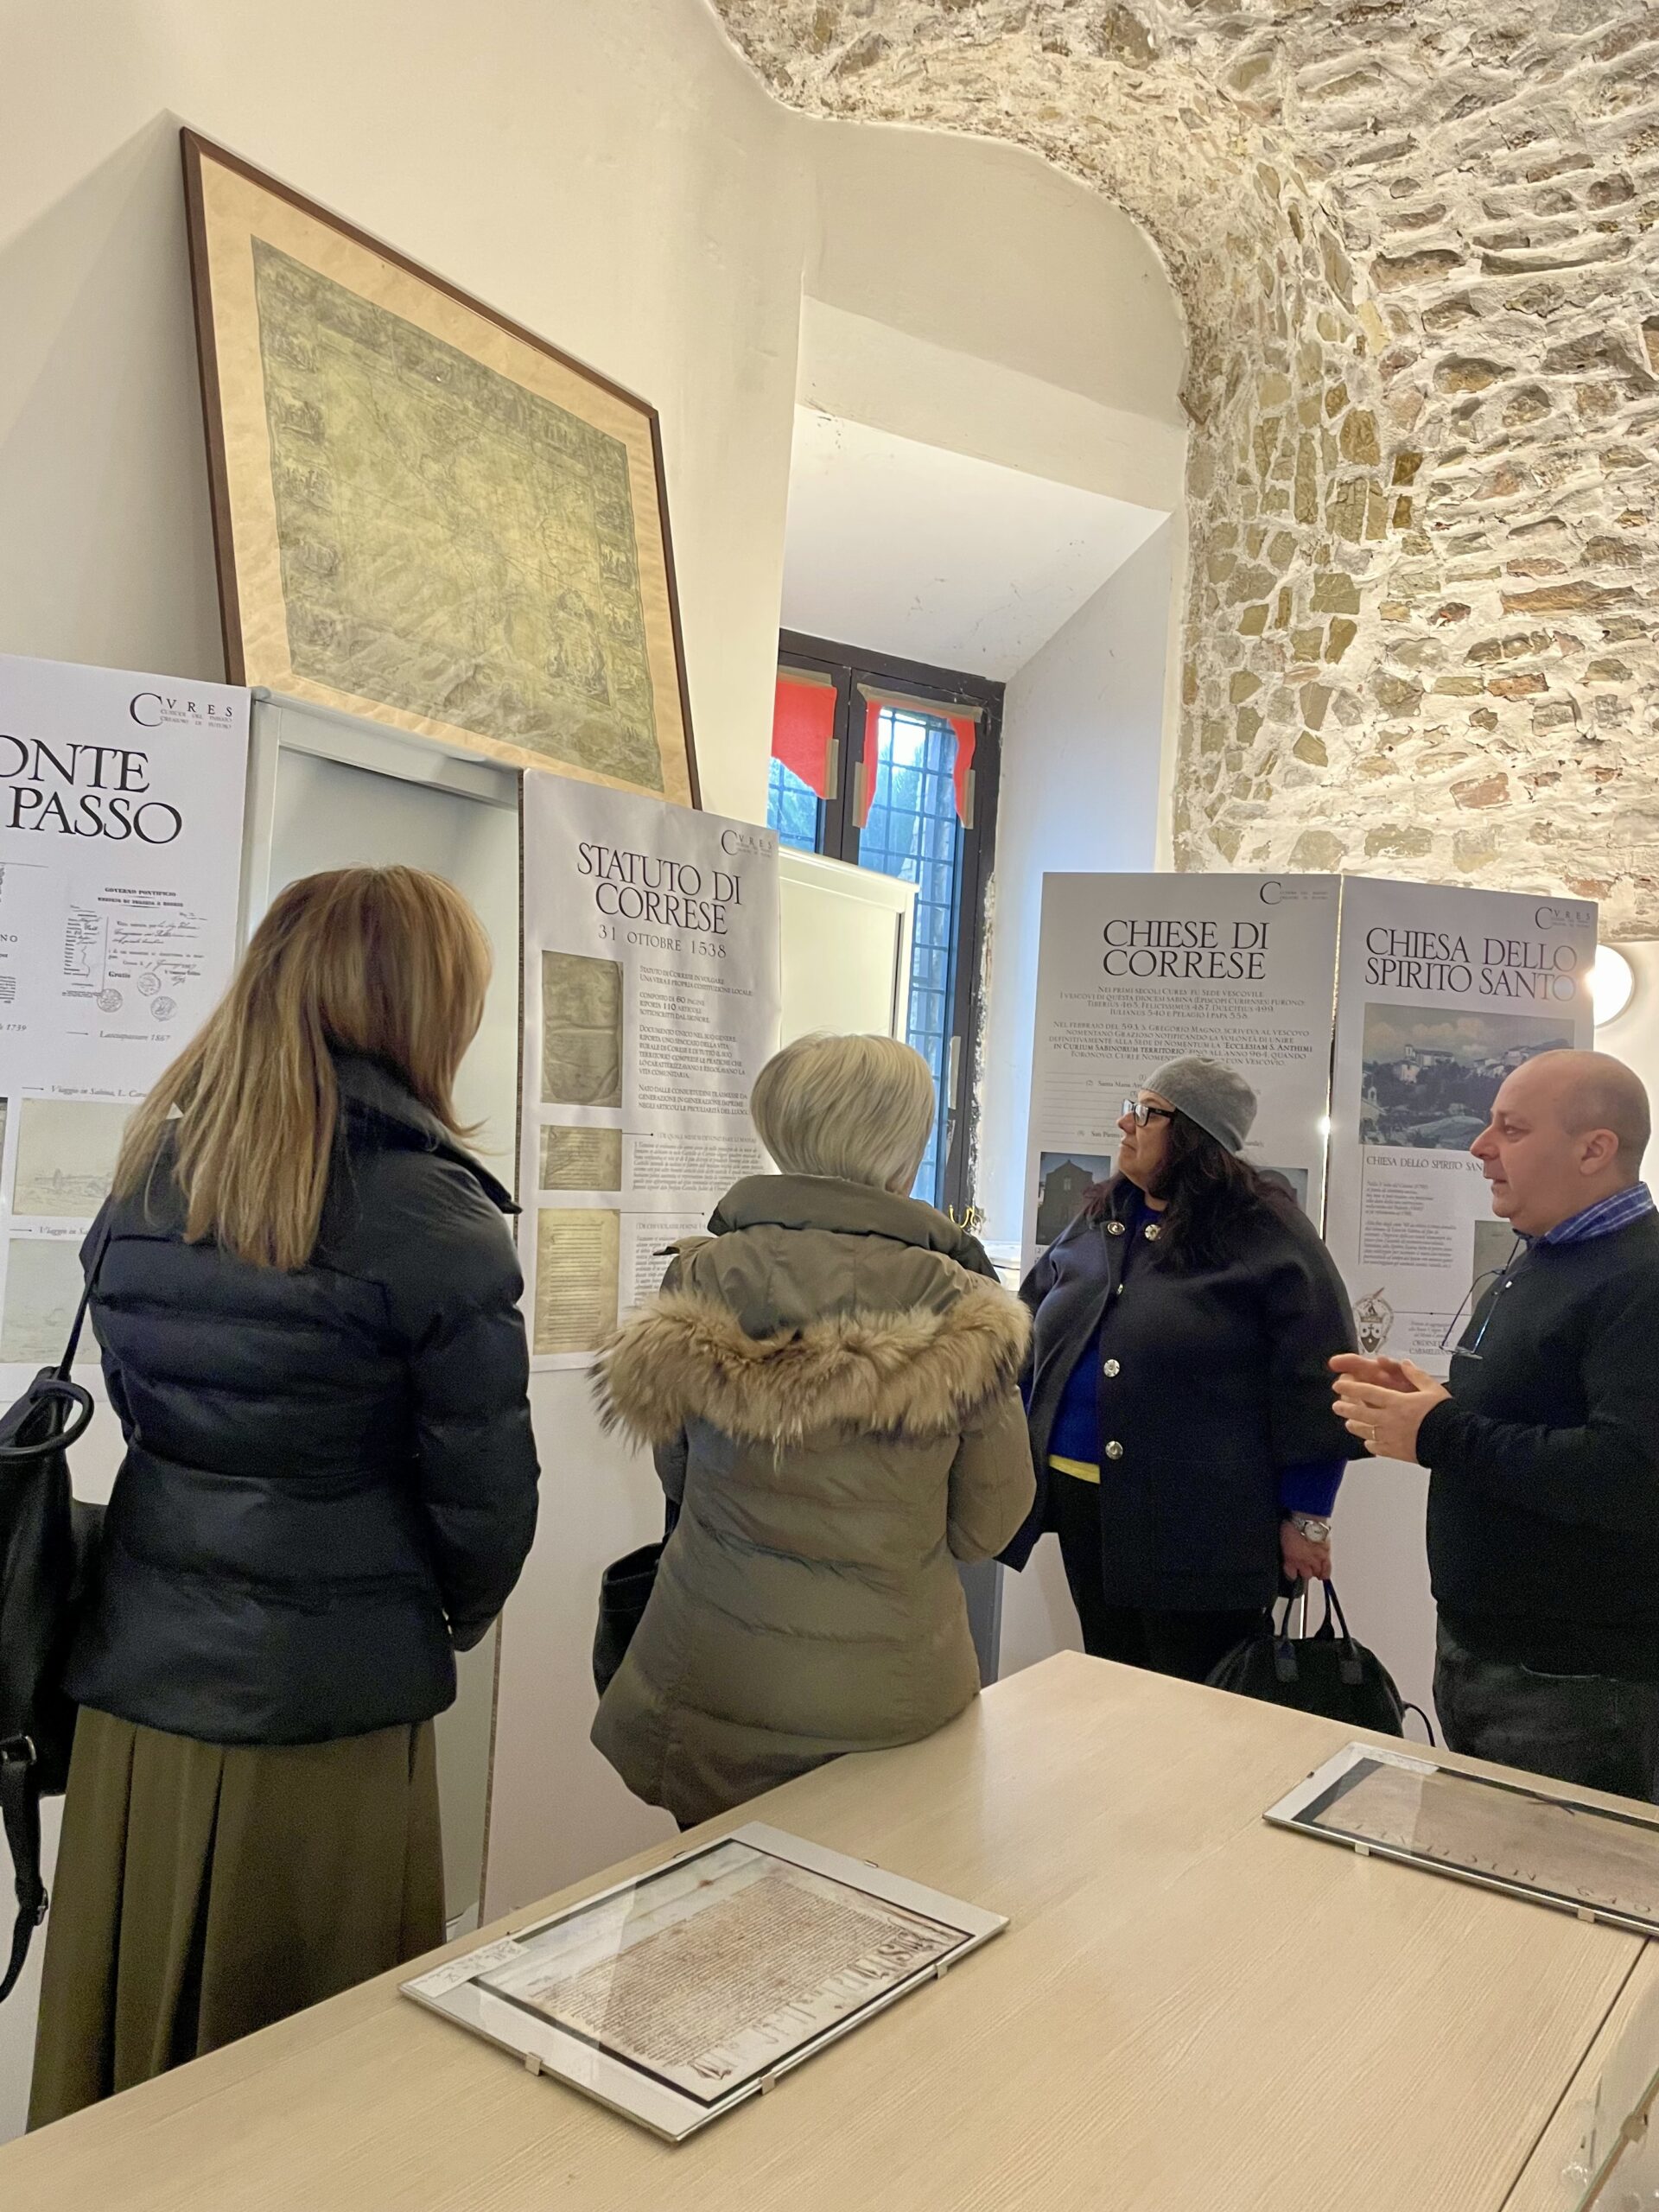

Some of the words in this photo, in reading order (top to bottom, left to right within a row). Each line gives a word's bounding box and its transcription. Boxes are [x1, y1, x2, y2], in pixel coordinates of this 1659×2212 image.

[130, 692, 233, 728] CVRES
[5, 786, 182, 844] PASSO
[721, 830, 772, 855] CVRES
[577, 842, 702, 896] STATUTO
[712, 871, 742, 906] DI
[595, 882, 728, 935] CORRESE
[1535, 906, 1591, 931] CVRES
[598, 925, 616, 941] 31
[626, 931, 681, 951] OTTOBRE
[690, 940, 727, 959] 1538
[1103, 919, 1217, 948] CHIESE
[1231, 921, 1270, 950] DI
[1365, 926, 1471, 963] CHIESA
[1483, 938, 1578, 973] DELLO
[1103, 949, 1266, 980] CORRESE
[1364, 957, 1473, 993] SPIRITO
[1478, 968, 1576, 1002] SANTO
[1366, 1155, 1397, 1166] CHIESA
[1401, 1158, 1429, 1168] DELLO
[1432, 1160, 1463, 1170] SPIRITO
[1465, 1162, 1484, 1172] SAN
